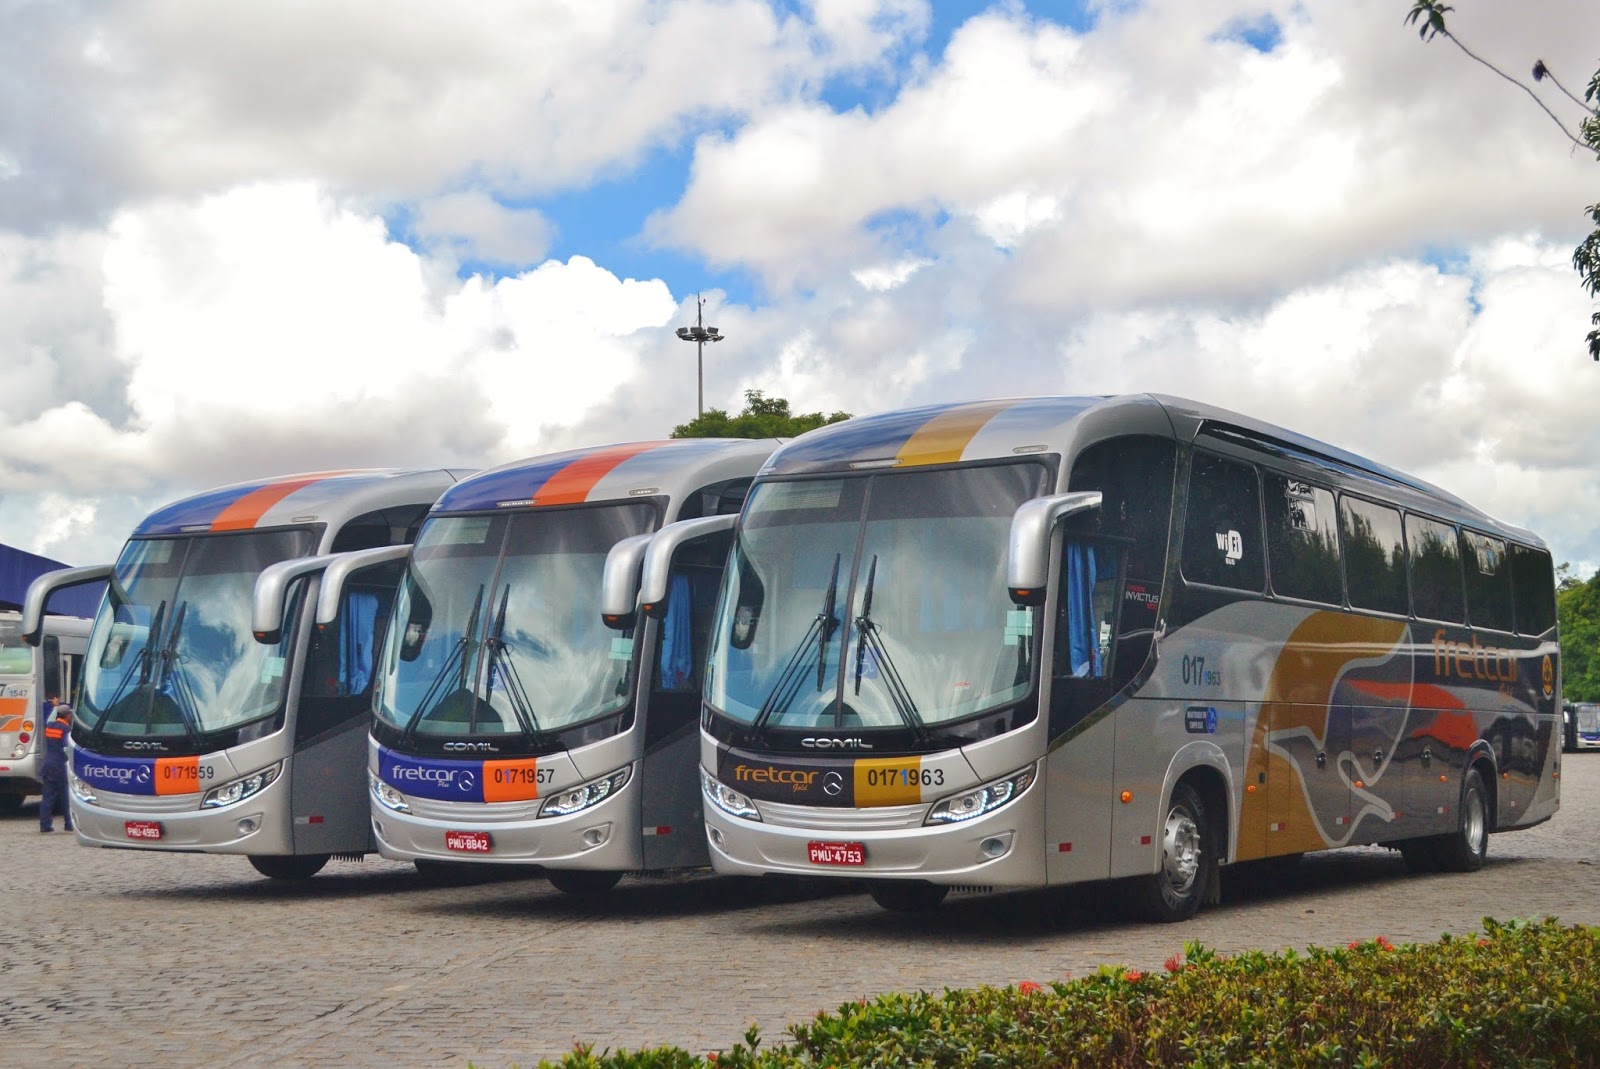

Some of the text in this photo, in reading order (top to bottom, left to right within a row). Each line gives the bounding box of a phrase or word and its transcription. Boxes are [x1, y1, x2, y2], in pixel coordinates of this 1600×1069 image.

[1125, 590, 1159, 604] INVICTUS
[123, 740, 169, 750] COMIL
[443, 742, 499, 752] COMIL
[801, 738, 873, 748] COMIL
[83, 763, 136, 780] fretcar
[164, 765, 214, 779] 0171959
[392, 764, 458, 781] fretcar
[494, 768, 555, 784] 0171957
[734, 765, 819, 785] fretcar
[868, 768, 945, 787] 0171963
[792, 783, 808, 792] Gold
[448, 838, 488, 850] PMU-8842
[811, 849, 862, 863] PMU-4753
